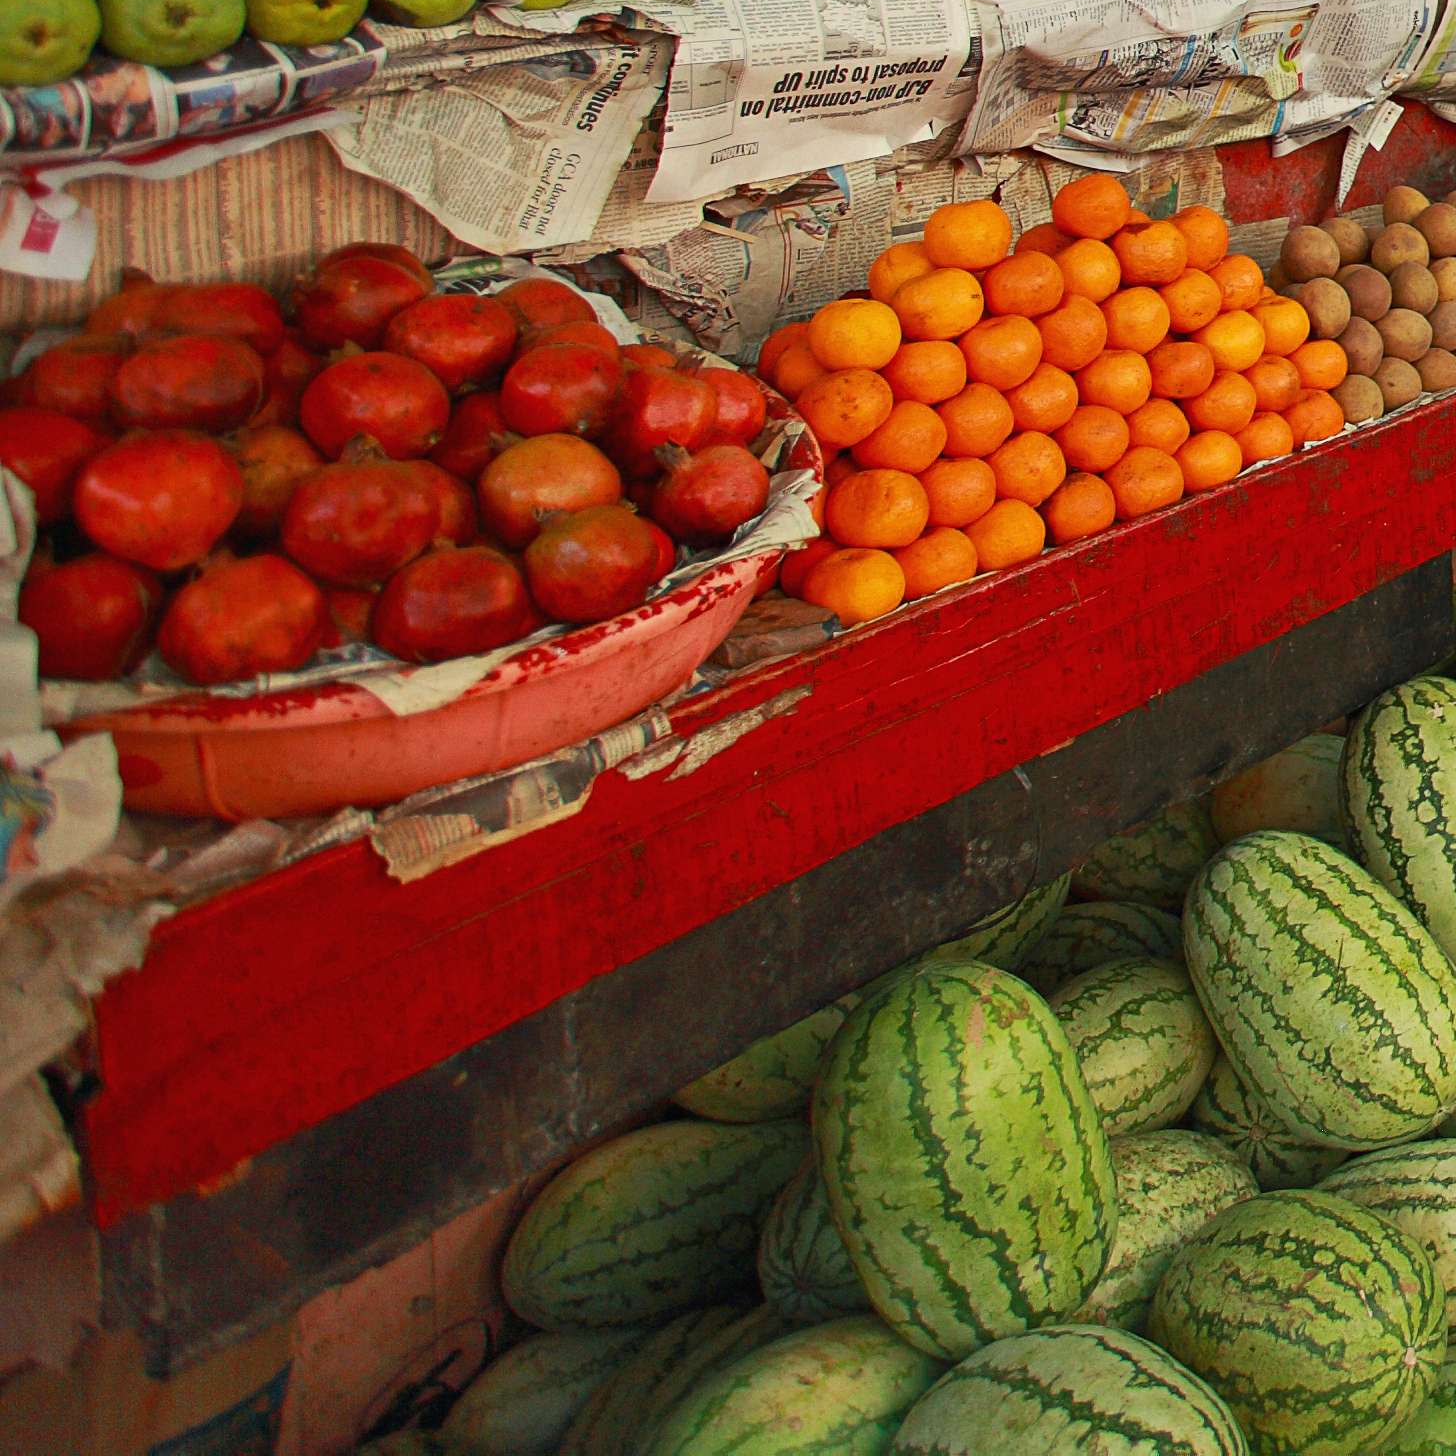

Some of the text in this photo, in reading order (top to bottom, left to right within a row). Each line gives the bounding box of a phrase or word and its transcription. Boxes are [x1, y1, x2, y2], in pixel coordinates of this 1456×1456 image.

[773, 55, 948, 94] proposal to split UP
[895, 79, 933, 100] BJP
[576, 59, 633, 133] continues
[740, 99, 765, 118] on
[765, 84, 898, 119] non-committal
[710, 142, 759, 165] NATIONAL
[519, 147, 562, 232] closed for Bhat
[535, 153, 582, 236] GCA doors not
